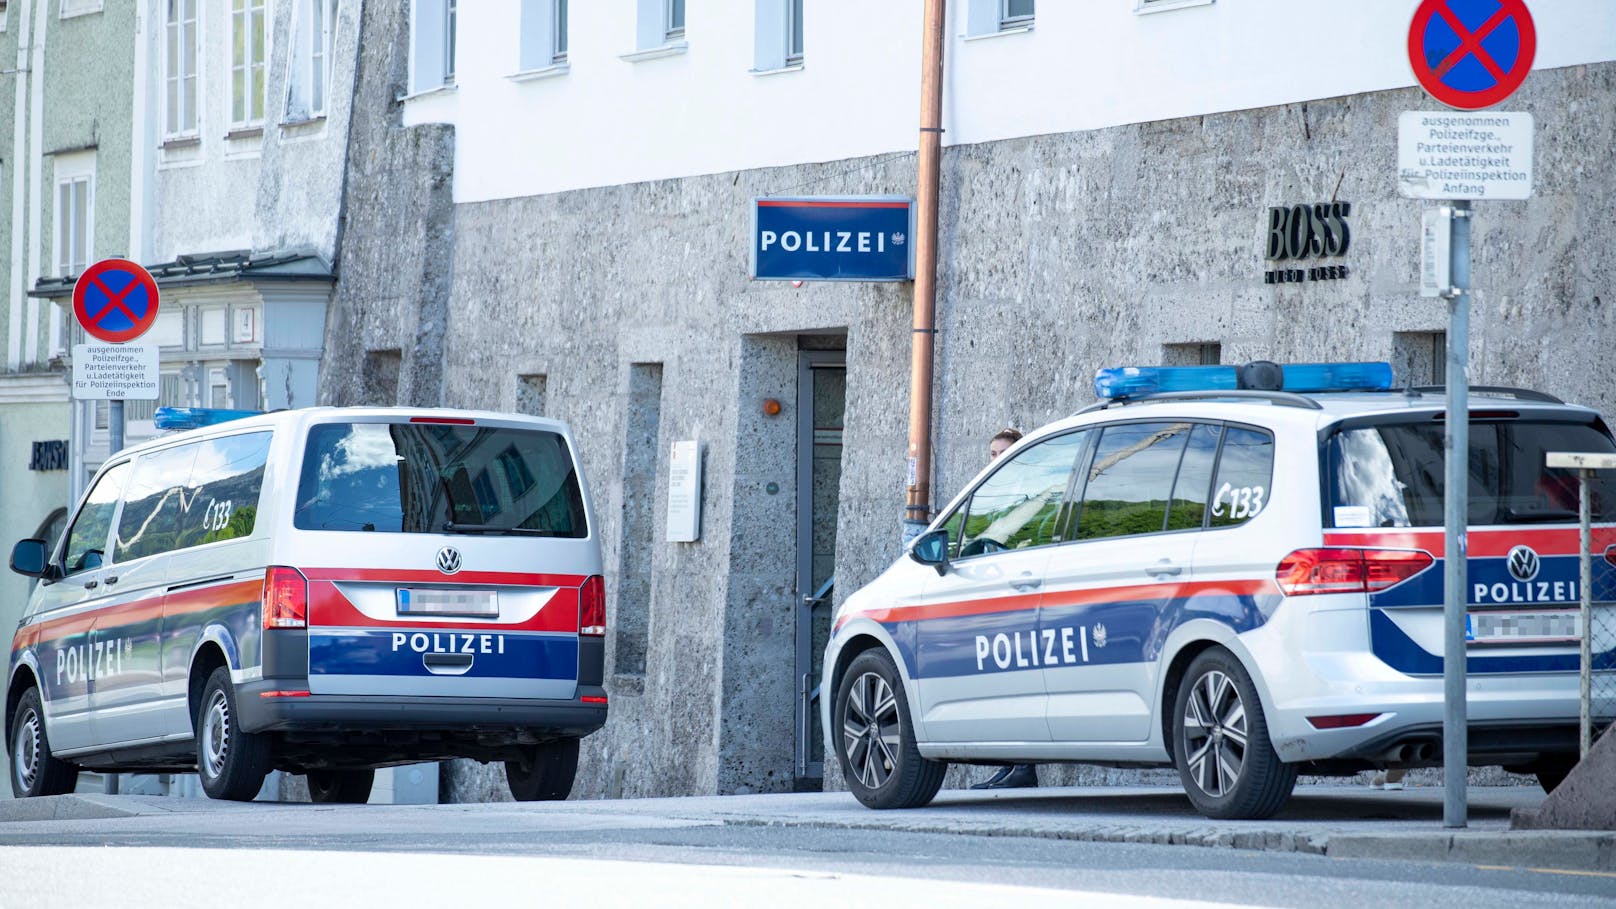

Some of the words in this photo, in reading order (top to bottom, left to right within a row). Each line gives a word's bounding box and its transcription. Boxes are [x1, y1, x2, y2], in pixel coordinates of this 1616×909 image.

[1421, 117, 1510, 128] ausgenommen
[1416, 143, 1514, 154] Parteienverkehr
[1425, 169, 1527, 182] Polizeiinspektion
[1442, 183, 1485, 196] Anfang
[1265, 200, 1351, 261] BOSS
[761, 230, 885, 253] POLIZEI
[87, 346, 144, 355] ausgenommen
[84, 363, 146, 371] Parteienverkehr
[90, 381, 156, 390] Polizeiinspektion
[106, 389, 125, 397] Ende
[1230, 486, 1264, 519] 133
[212, 499, 232, 531] 133
[1474, 581, 1576, 603] POLIZEI
[391, 632, 505, 654] POLIZEI
[975, 626, 1089, 671] POLIZEI
[56, 638, 122, 686] POLIZEI
